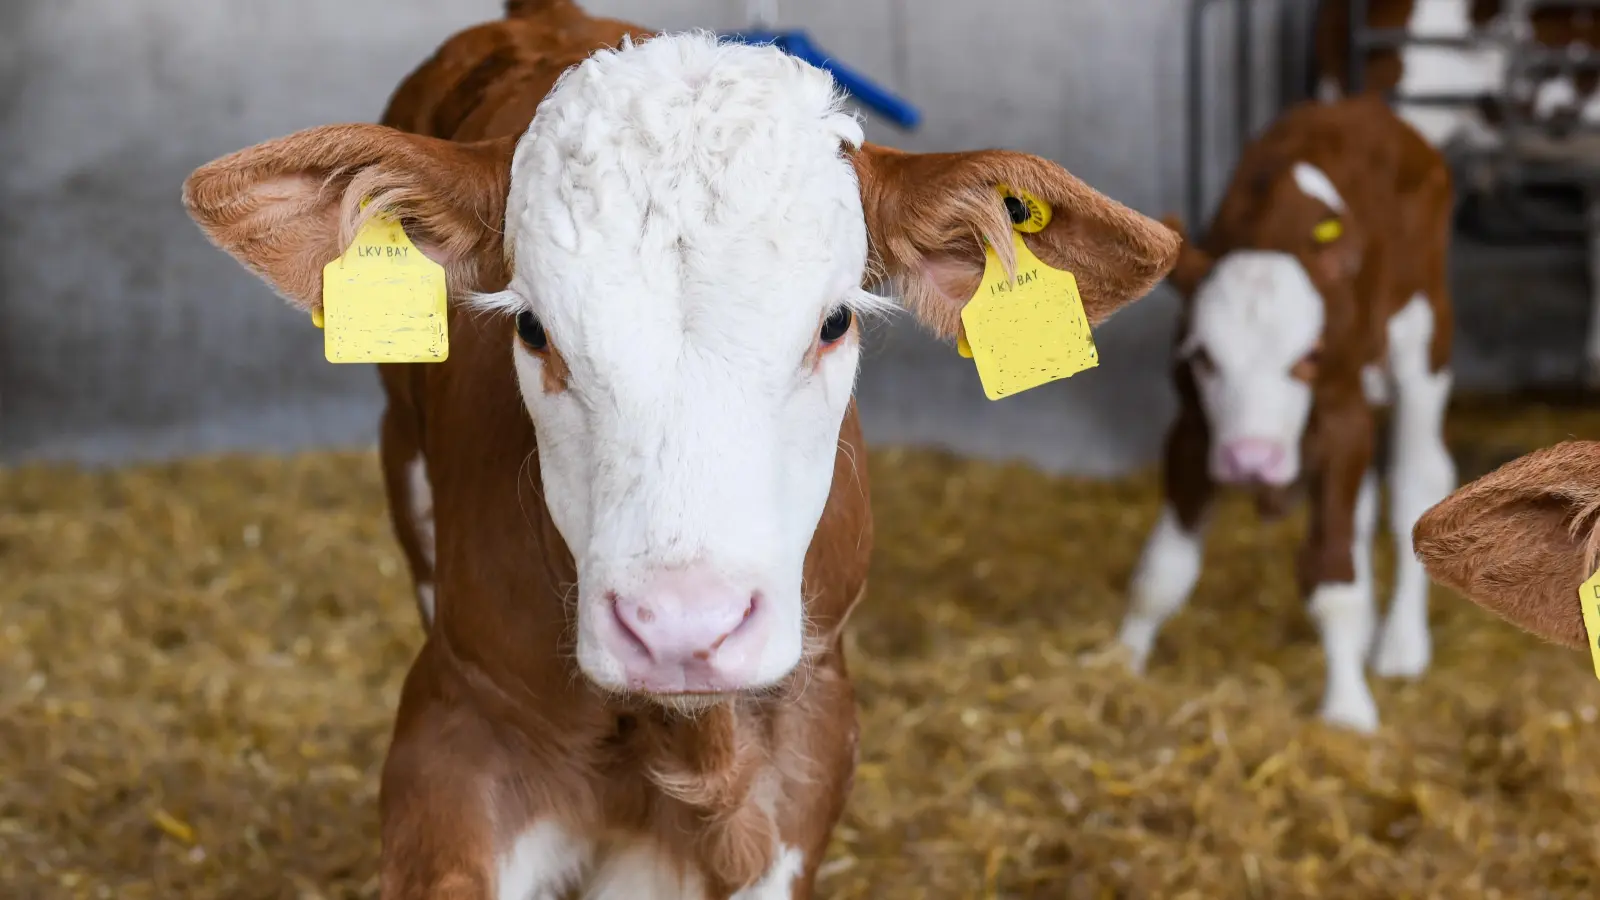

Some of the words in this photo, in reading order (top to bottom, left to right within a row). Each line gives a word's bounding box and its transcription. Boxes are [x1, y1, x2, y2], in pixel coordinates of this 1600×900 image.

[358, 245, 382, 257] LKV
[386, 246, 409, 257] BAY
[1016, 269, 1038, 286] BAY
